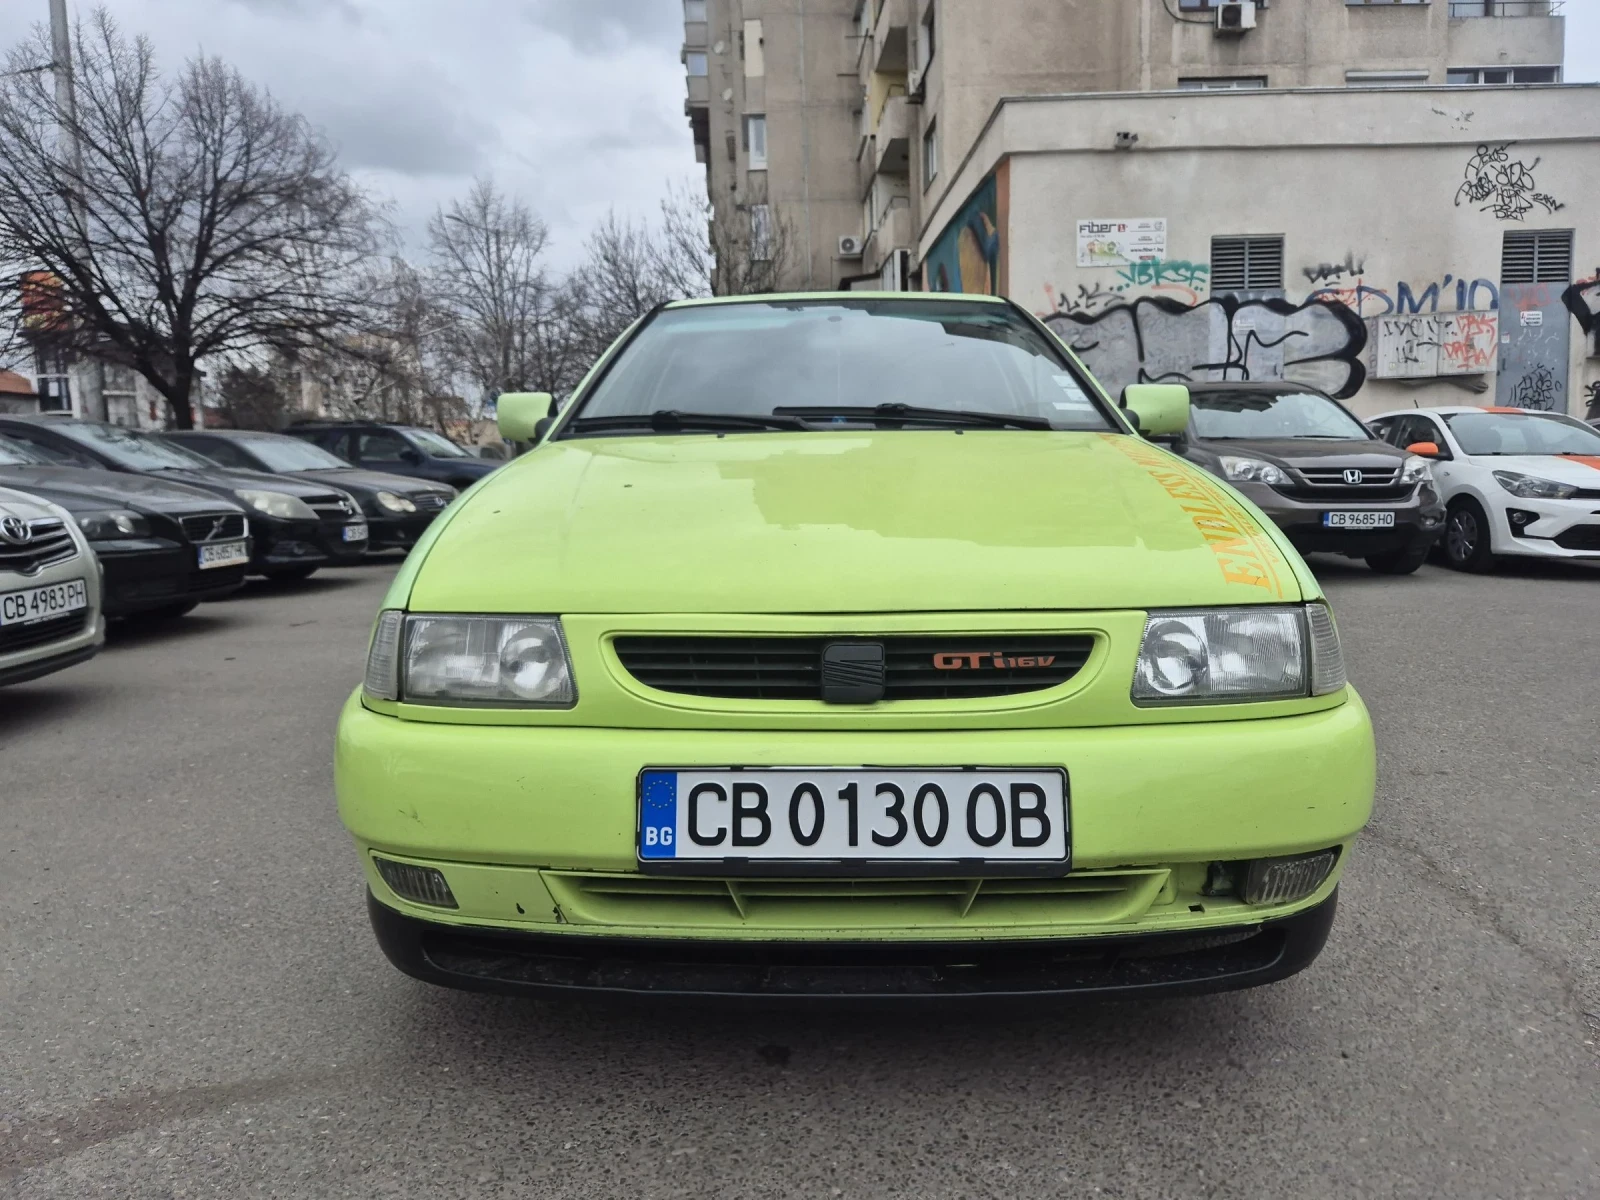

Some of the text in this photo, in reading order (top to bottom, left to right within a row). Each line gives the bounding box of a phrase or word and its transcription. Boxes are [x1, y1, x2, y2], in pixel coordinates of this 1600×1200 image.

[1079, 221, 1116, 233] Fiber
[1148, 470, 1272, 594] ENDLESS
[1331, 514, 1346, 525] CB
[1348, 514, 1376, 525] 9685
[4, 594, 27, 620] CB
[30, 587, 66, 614] 4983
[67, 583, 84, 606] PH
[687, 782, 772, 848] CB
[788, 781, 950, 848] 0130
[645, 827, 674, 846] BG
